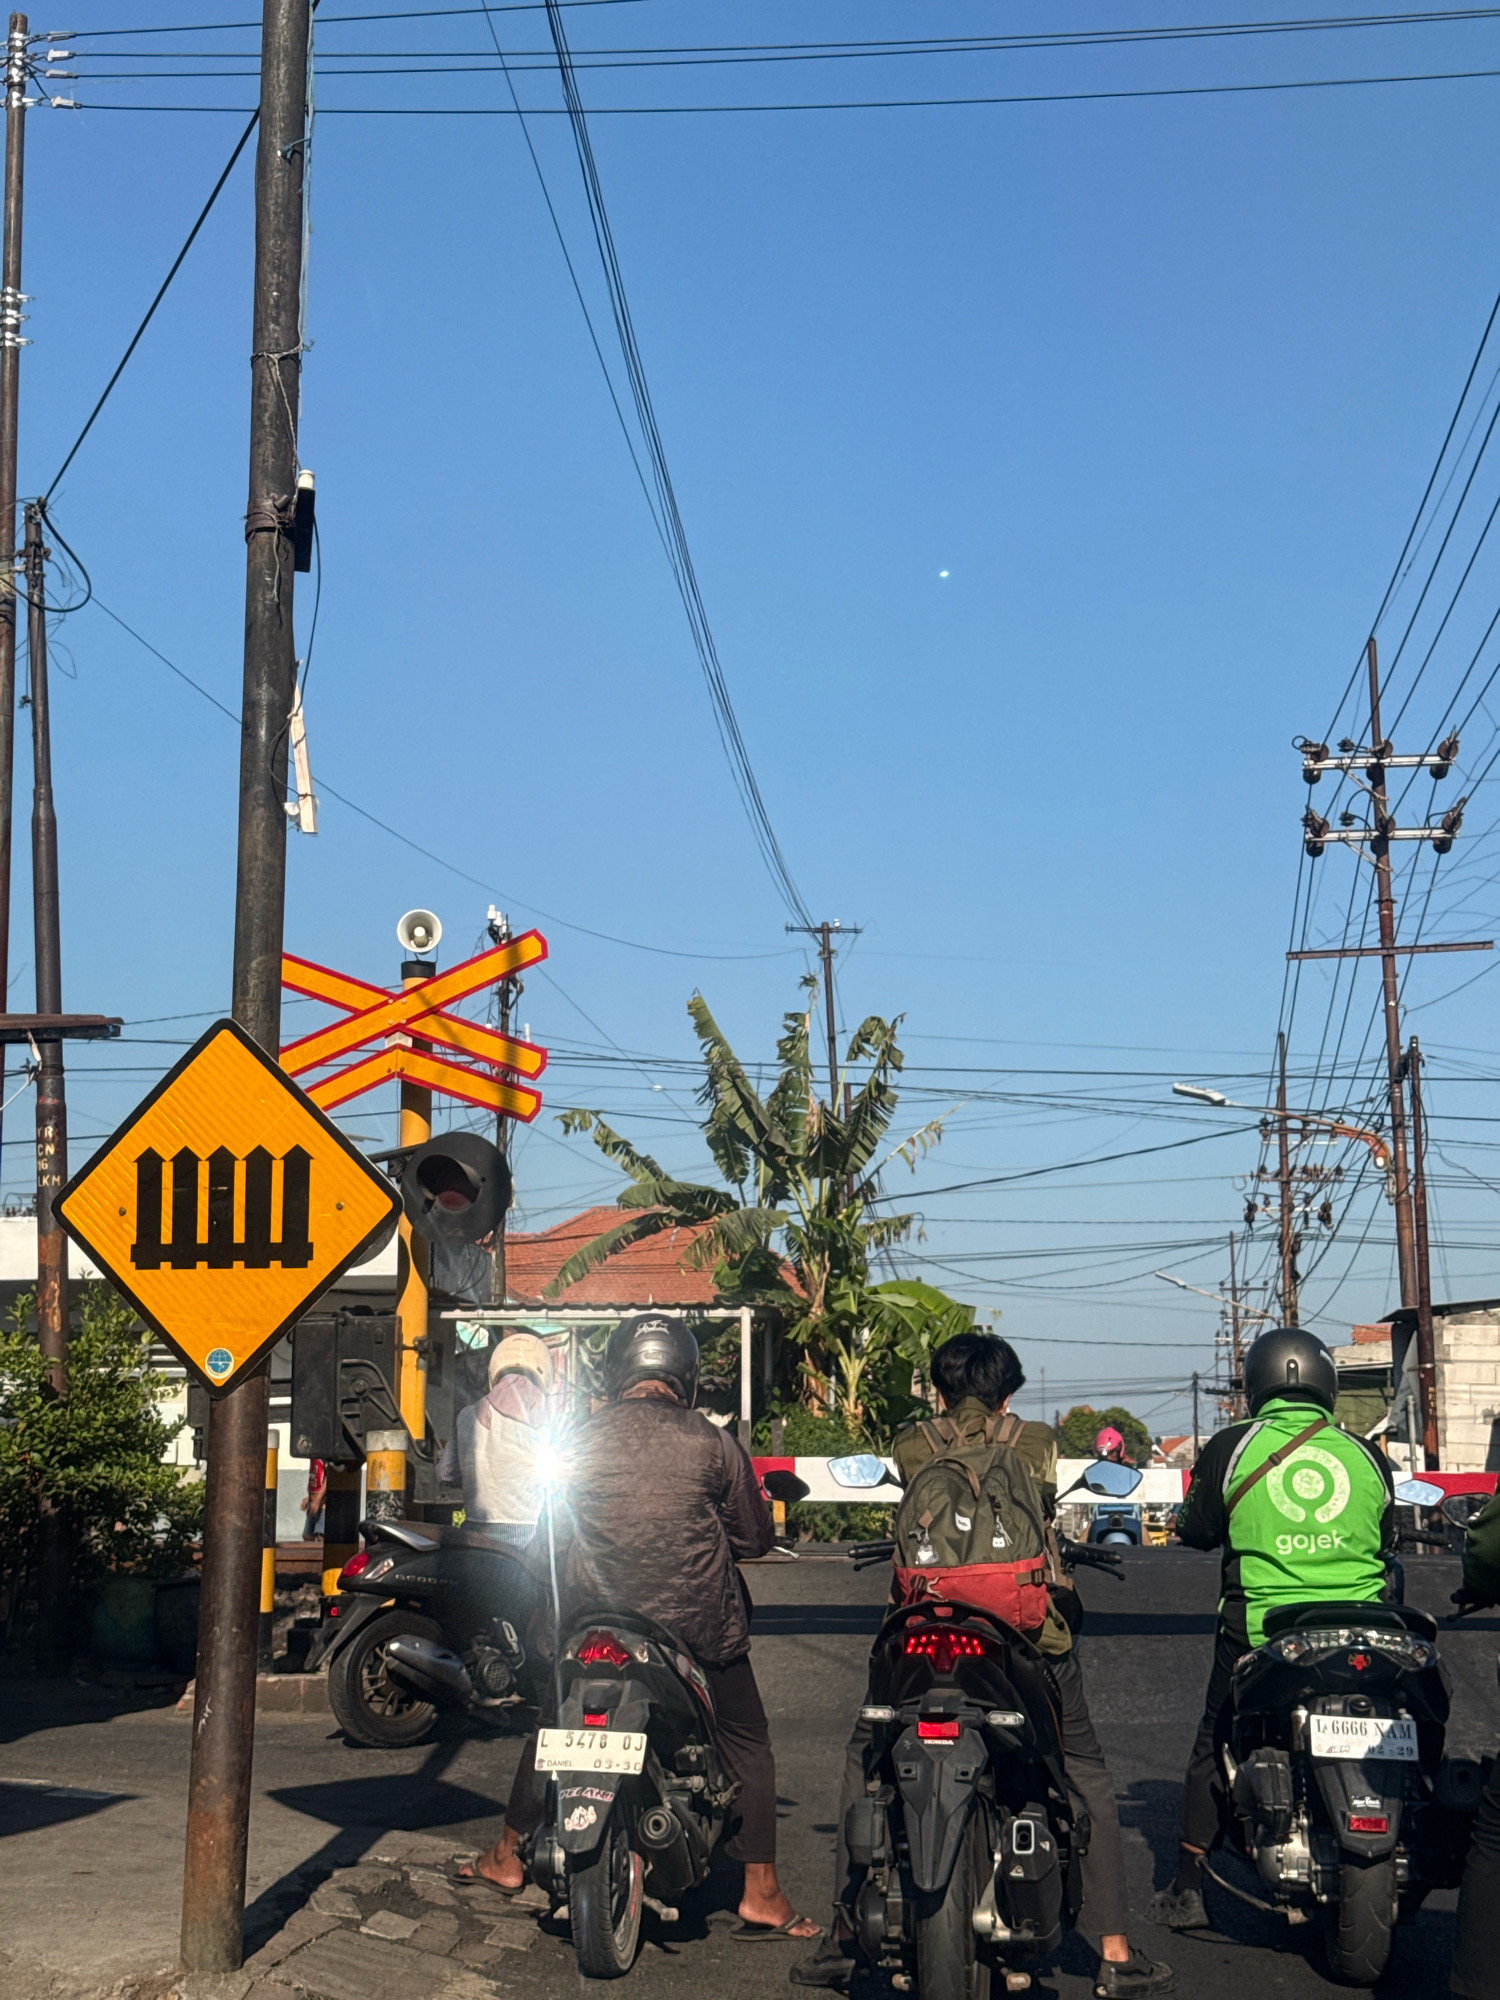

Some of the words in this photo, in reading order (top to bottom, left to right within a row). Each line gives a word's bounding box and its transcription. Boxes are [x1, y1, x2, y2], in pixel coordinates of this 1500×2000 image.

[1275, 1530, 1348, 1555] gojek
[1331, 1719, 1368, 1736] 6666
[1374, 1722, 1413, 1740] NAM
[540, 1732, 548, 1748] L
[547, 1759, 573, 1767] DANIEL
